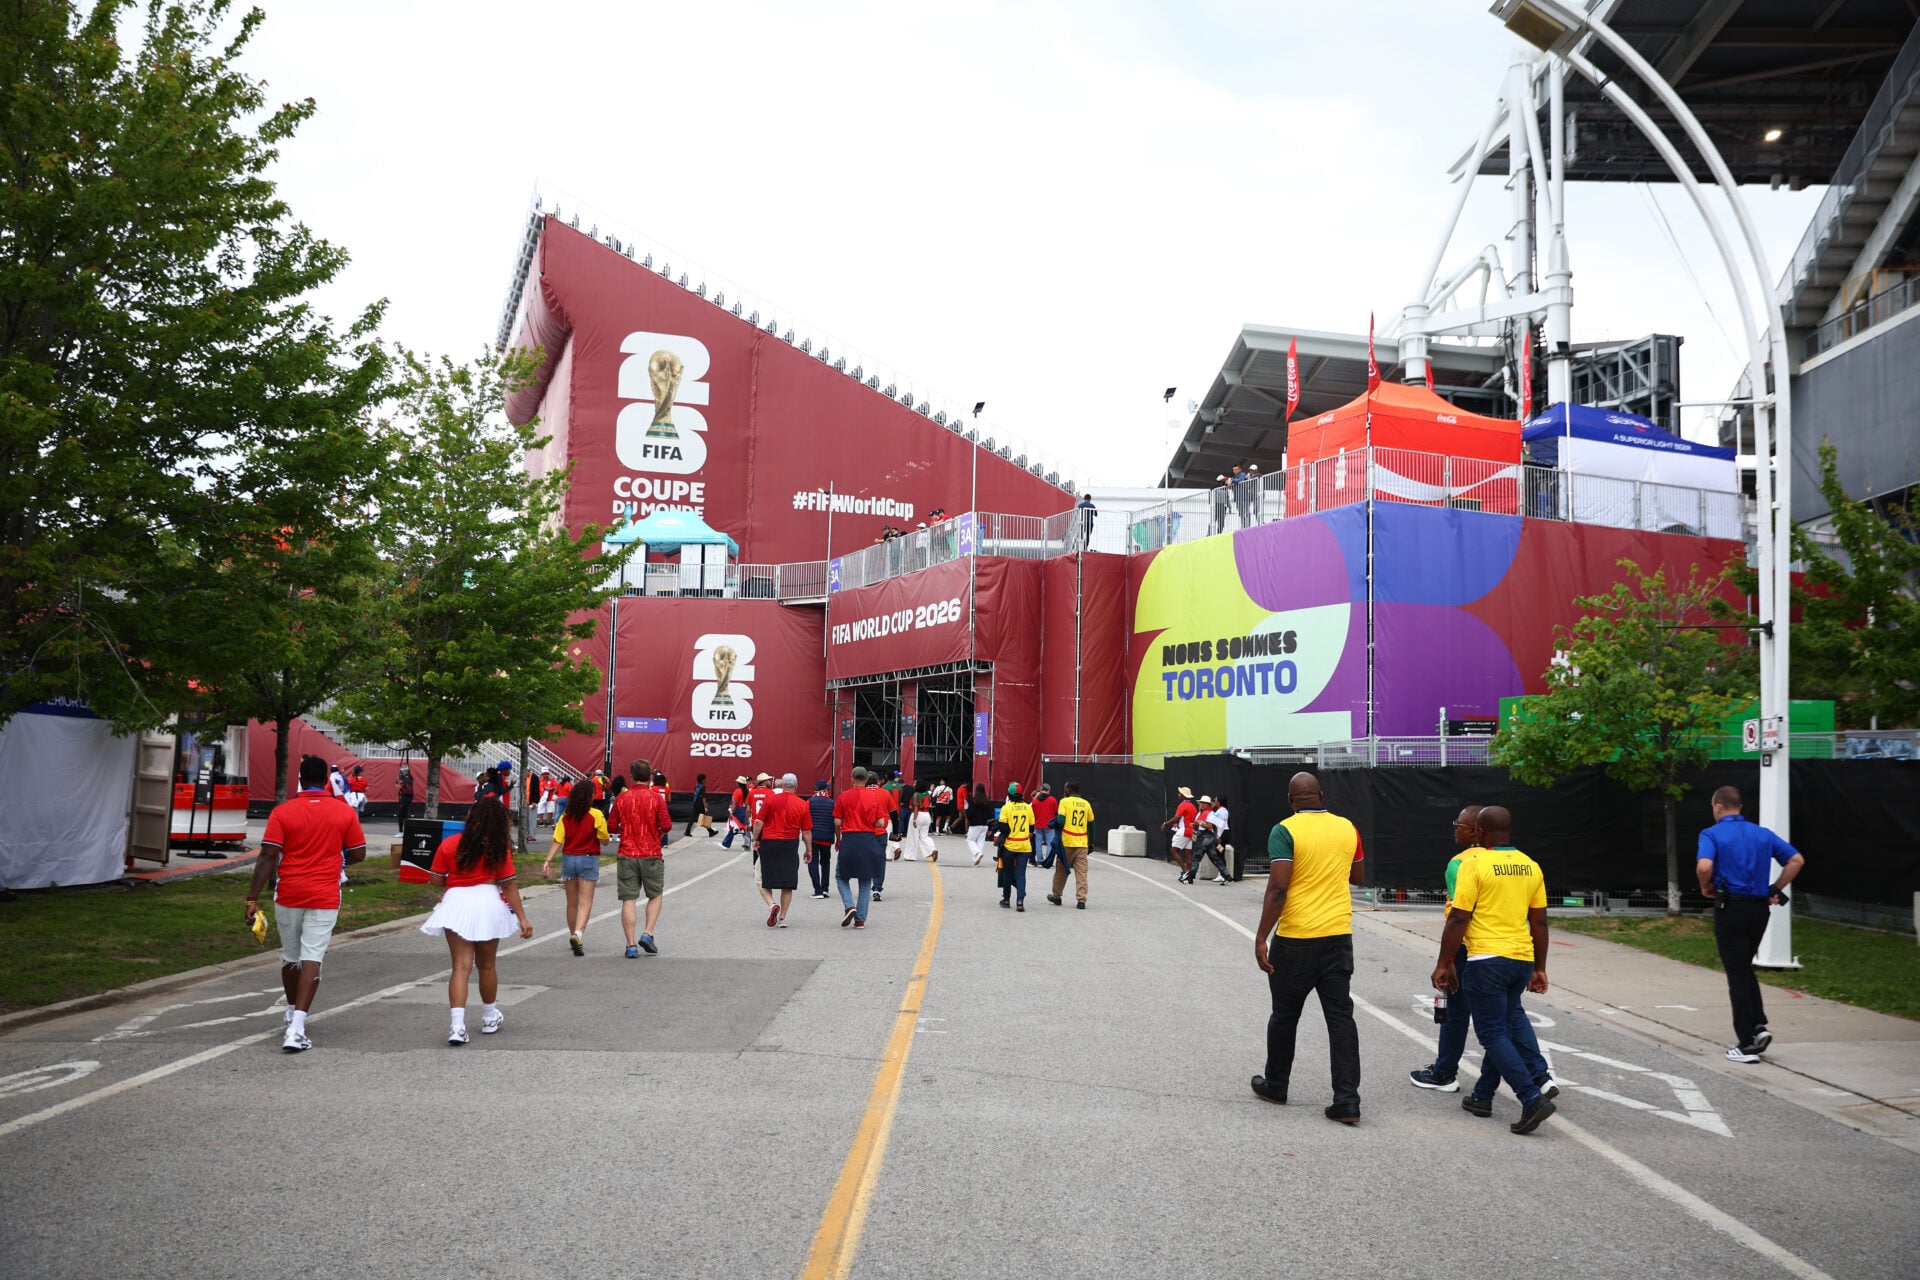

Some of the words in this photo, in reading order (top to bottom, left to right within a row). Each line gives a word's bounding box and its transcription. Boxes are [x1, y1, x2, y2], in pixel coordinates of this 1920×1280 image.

[1620, 435, 1653, 447] SUPERIOR
[1654, 440, 1673, 449] LIGHT
[1674, 443, 1692, 451] BEER
[642, 444, 683, 461] FIFA
[613, 476, 706, 503] COUPE
[793, 491, 914, 521] #FIFAWorldCup
[961, 528, 972, 546] 3A
[831, 569, 840, 584] 3A
[832, 623, 851, 646] FIFA
[852, 615, 890, 641] WORLD
[891, 609, 914, 634] CUP
[915, 598, 961, 629] 2026
[1216, 630, 1298, 660] SOMMES
[1162, 660, 1298, 701] TORONTO
[708, 710, 737, 721] FIFA
[691, 732, 729, 742] WORLD
[731, 733, 753, 743] CUP
[690, 743, 753, 758] 2026
[1013, 815, 1027, 833] 72
[1072, 809, 1085, 826] 62
